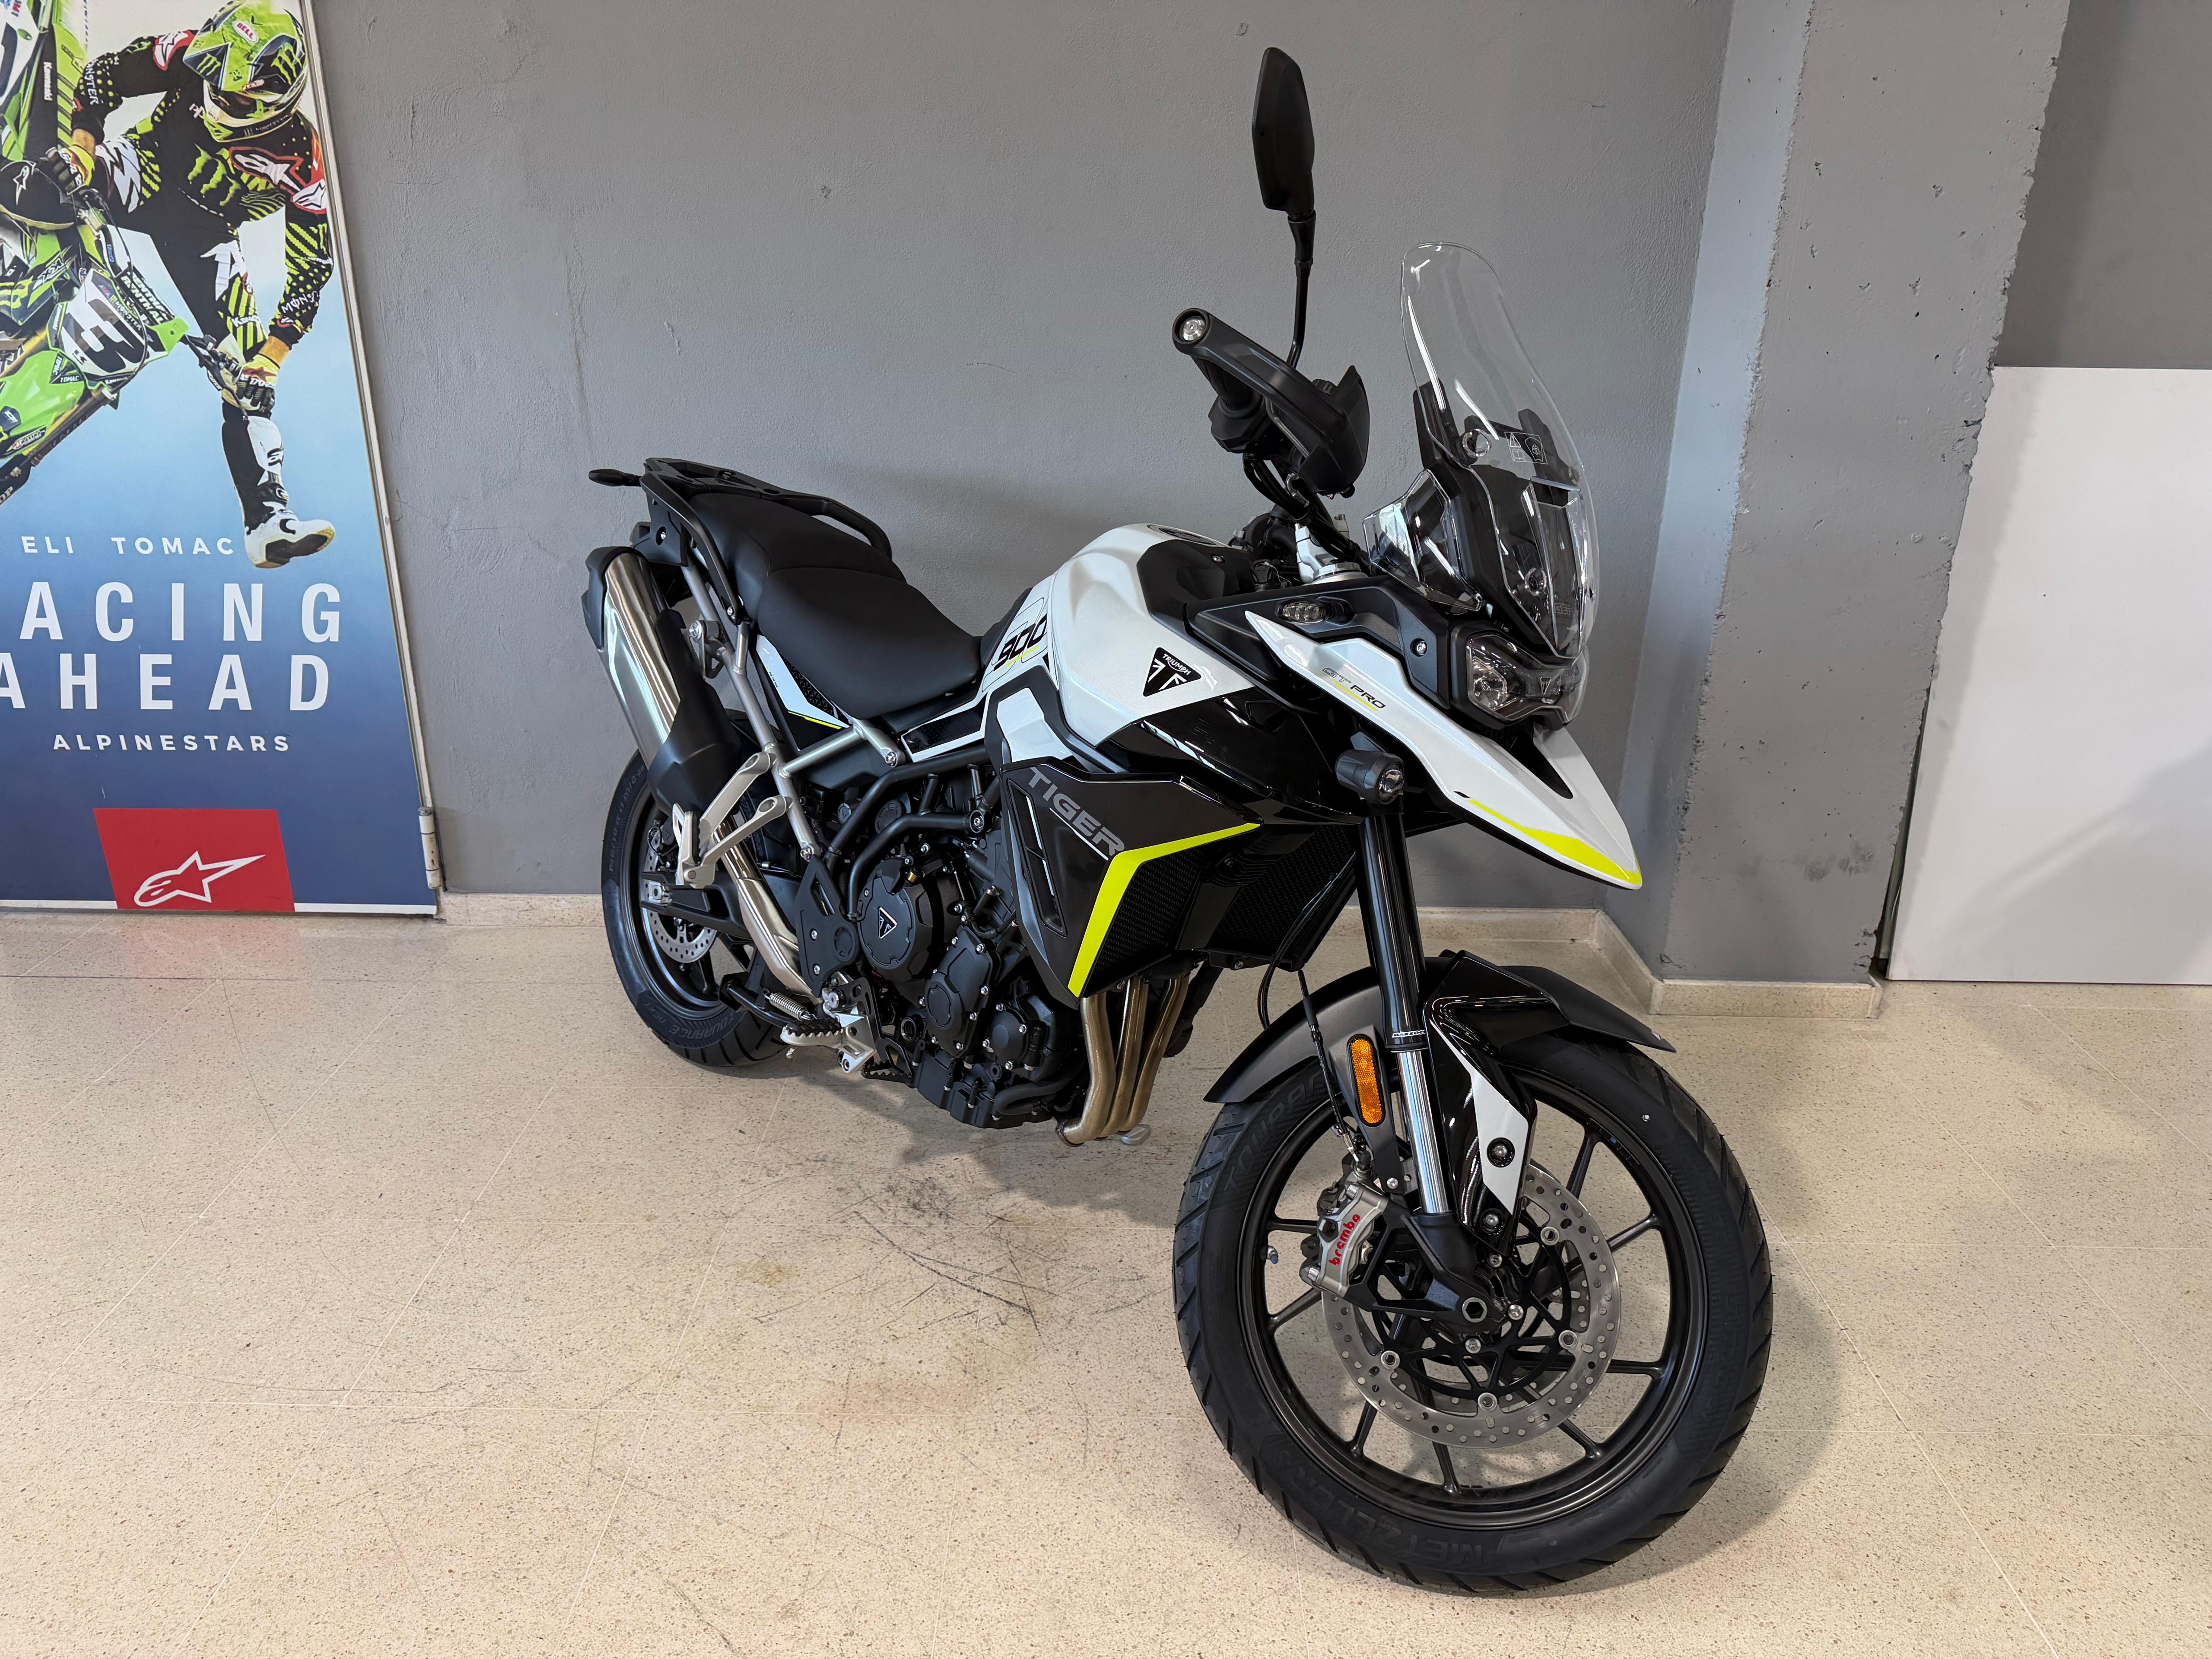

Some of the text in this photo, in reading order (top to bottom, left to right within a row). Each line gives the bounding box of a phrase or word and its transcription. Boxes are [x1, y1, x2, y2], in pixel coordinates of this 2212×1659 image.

[236, 22, 254, 39] BELL
[121, 275, 164, 324] RENTHAL
[22, 536, 234, 555] ELI TOMAC
[19, 581, 340, 642] ACING
[0, 652, 329, 711] AHEAD
[1162, 653, 1192, 675] TRIUMPH
[1322, 667, 1386, 709] GT PRO
[53, 734, 289, 752] ALPINESTARS
[1028, 767, 1125, 856] TIGER
[1392, 1030, 1426, 1038] MARZOC
[1328, 1214, 1361, 1266] brembo
